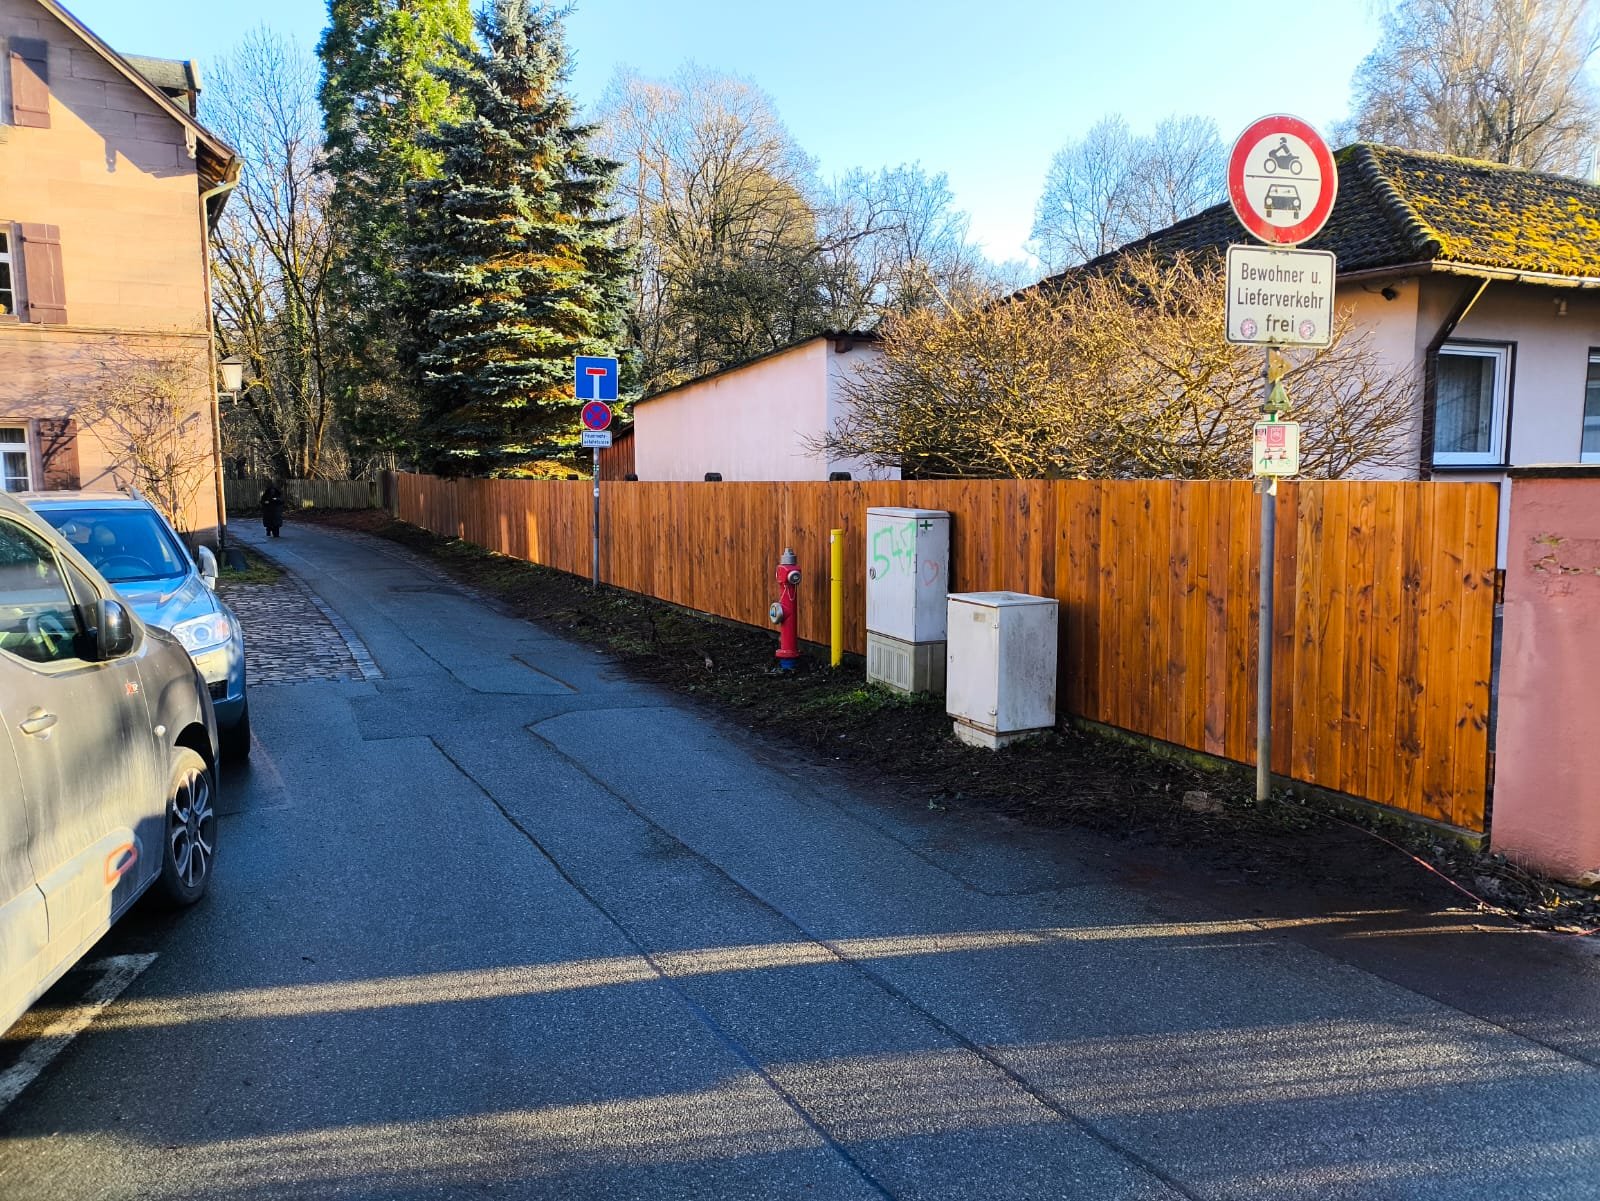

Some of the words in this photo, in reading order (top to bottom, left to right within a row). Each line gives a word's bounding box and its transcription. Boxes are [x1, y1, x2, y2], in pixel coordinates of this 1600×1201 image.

[1241, 262, 1304, 283] Bewohner
[1311, 271, 1321, 284] u.
[1237, 287, 1324, 309] Lieferverkehr
[1266, 314, 1294, 332] frei
